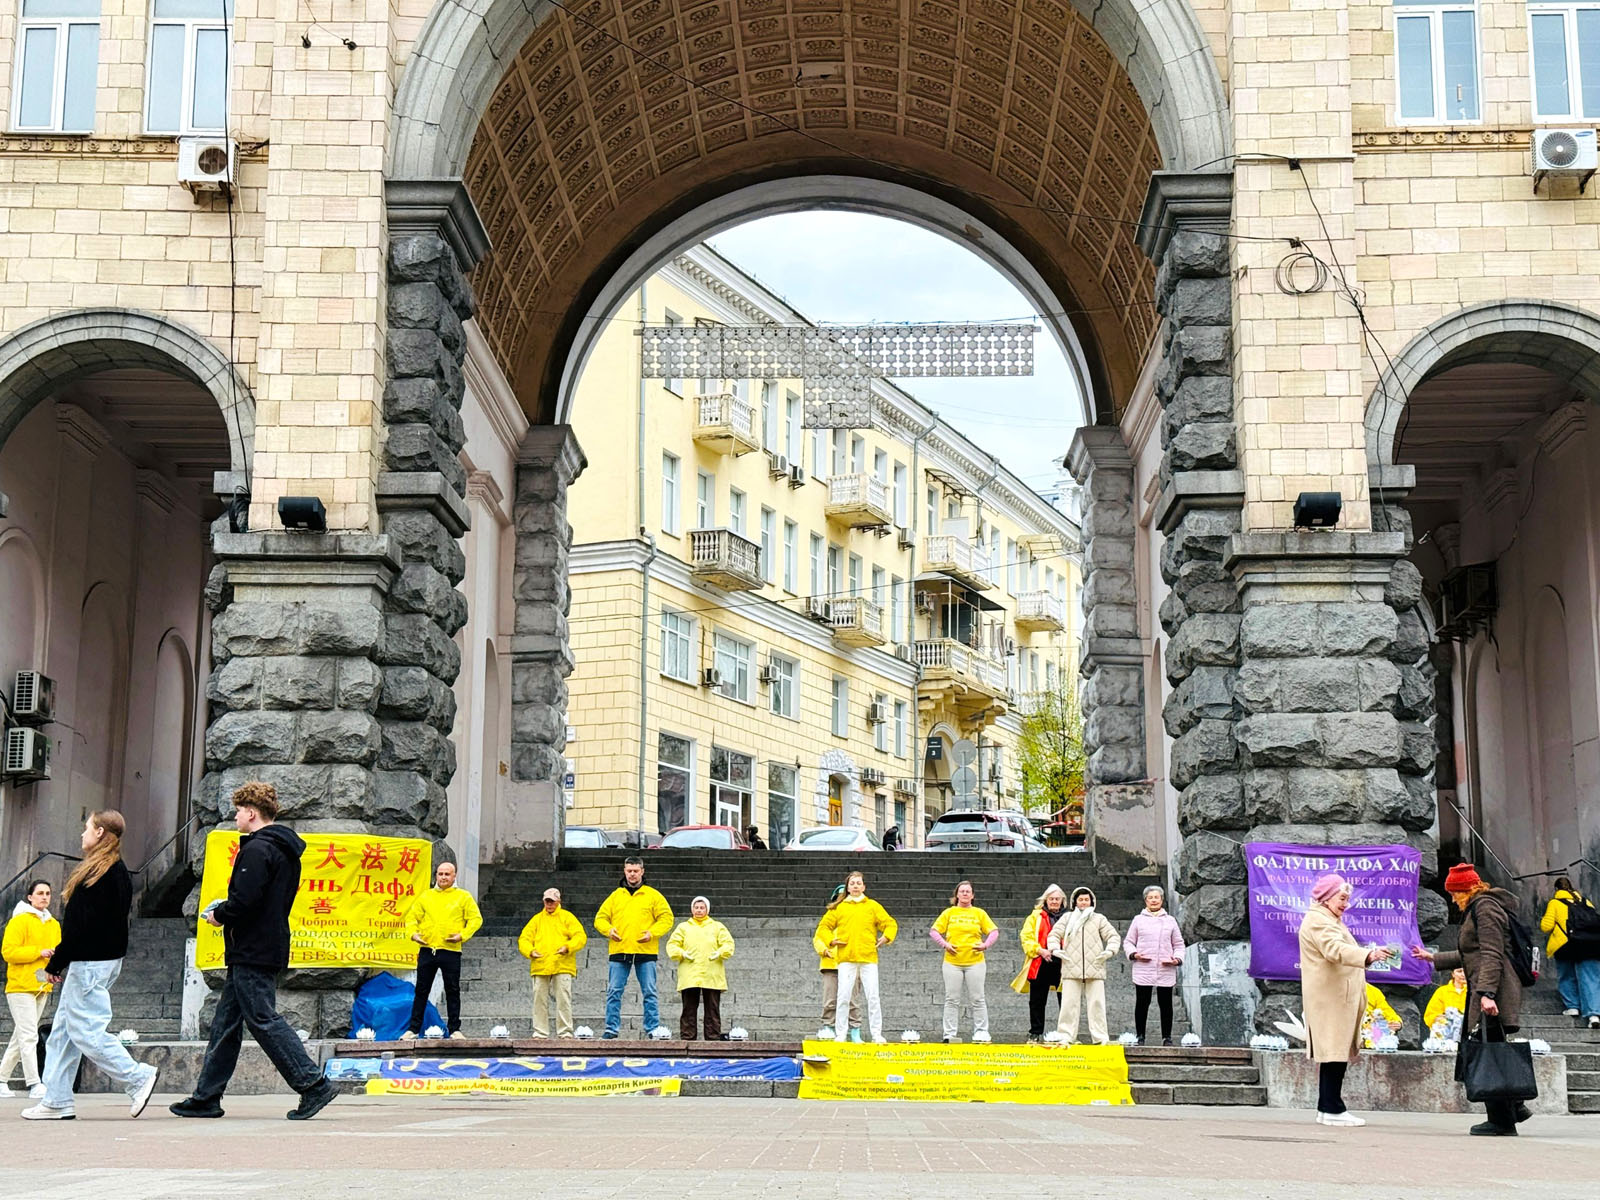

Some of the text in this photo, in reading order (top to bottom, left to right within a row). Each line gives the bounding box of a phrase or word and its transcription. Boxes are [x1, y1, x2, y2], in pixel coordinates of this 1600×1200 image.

[1253, 855, 1330, 870] ФАЛУНЬ
[1333, 858, 1384, 873] ДАФА
[351, 874, 415, 900] Дафа
[309, 896, 402, 917] 善 忍
[1256, 894, 1305, 907] ЧЖЕНЬ
[1355, 897, 1395, 910] ЖЕНЬ
[318, 941, 337, 949] ТА
[302, 950, 419, 963] БЕЗКОШТОВ
[517, 1086, 545, 1094] зараз
[581, 1077, 630, 1092] компартія
